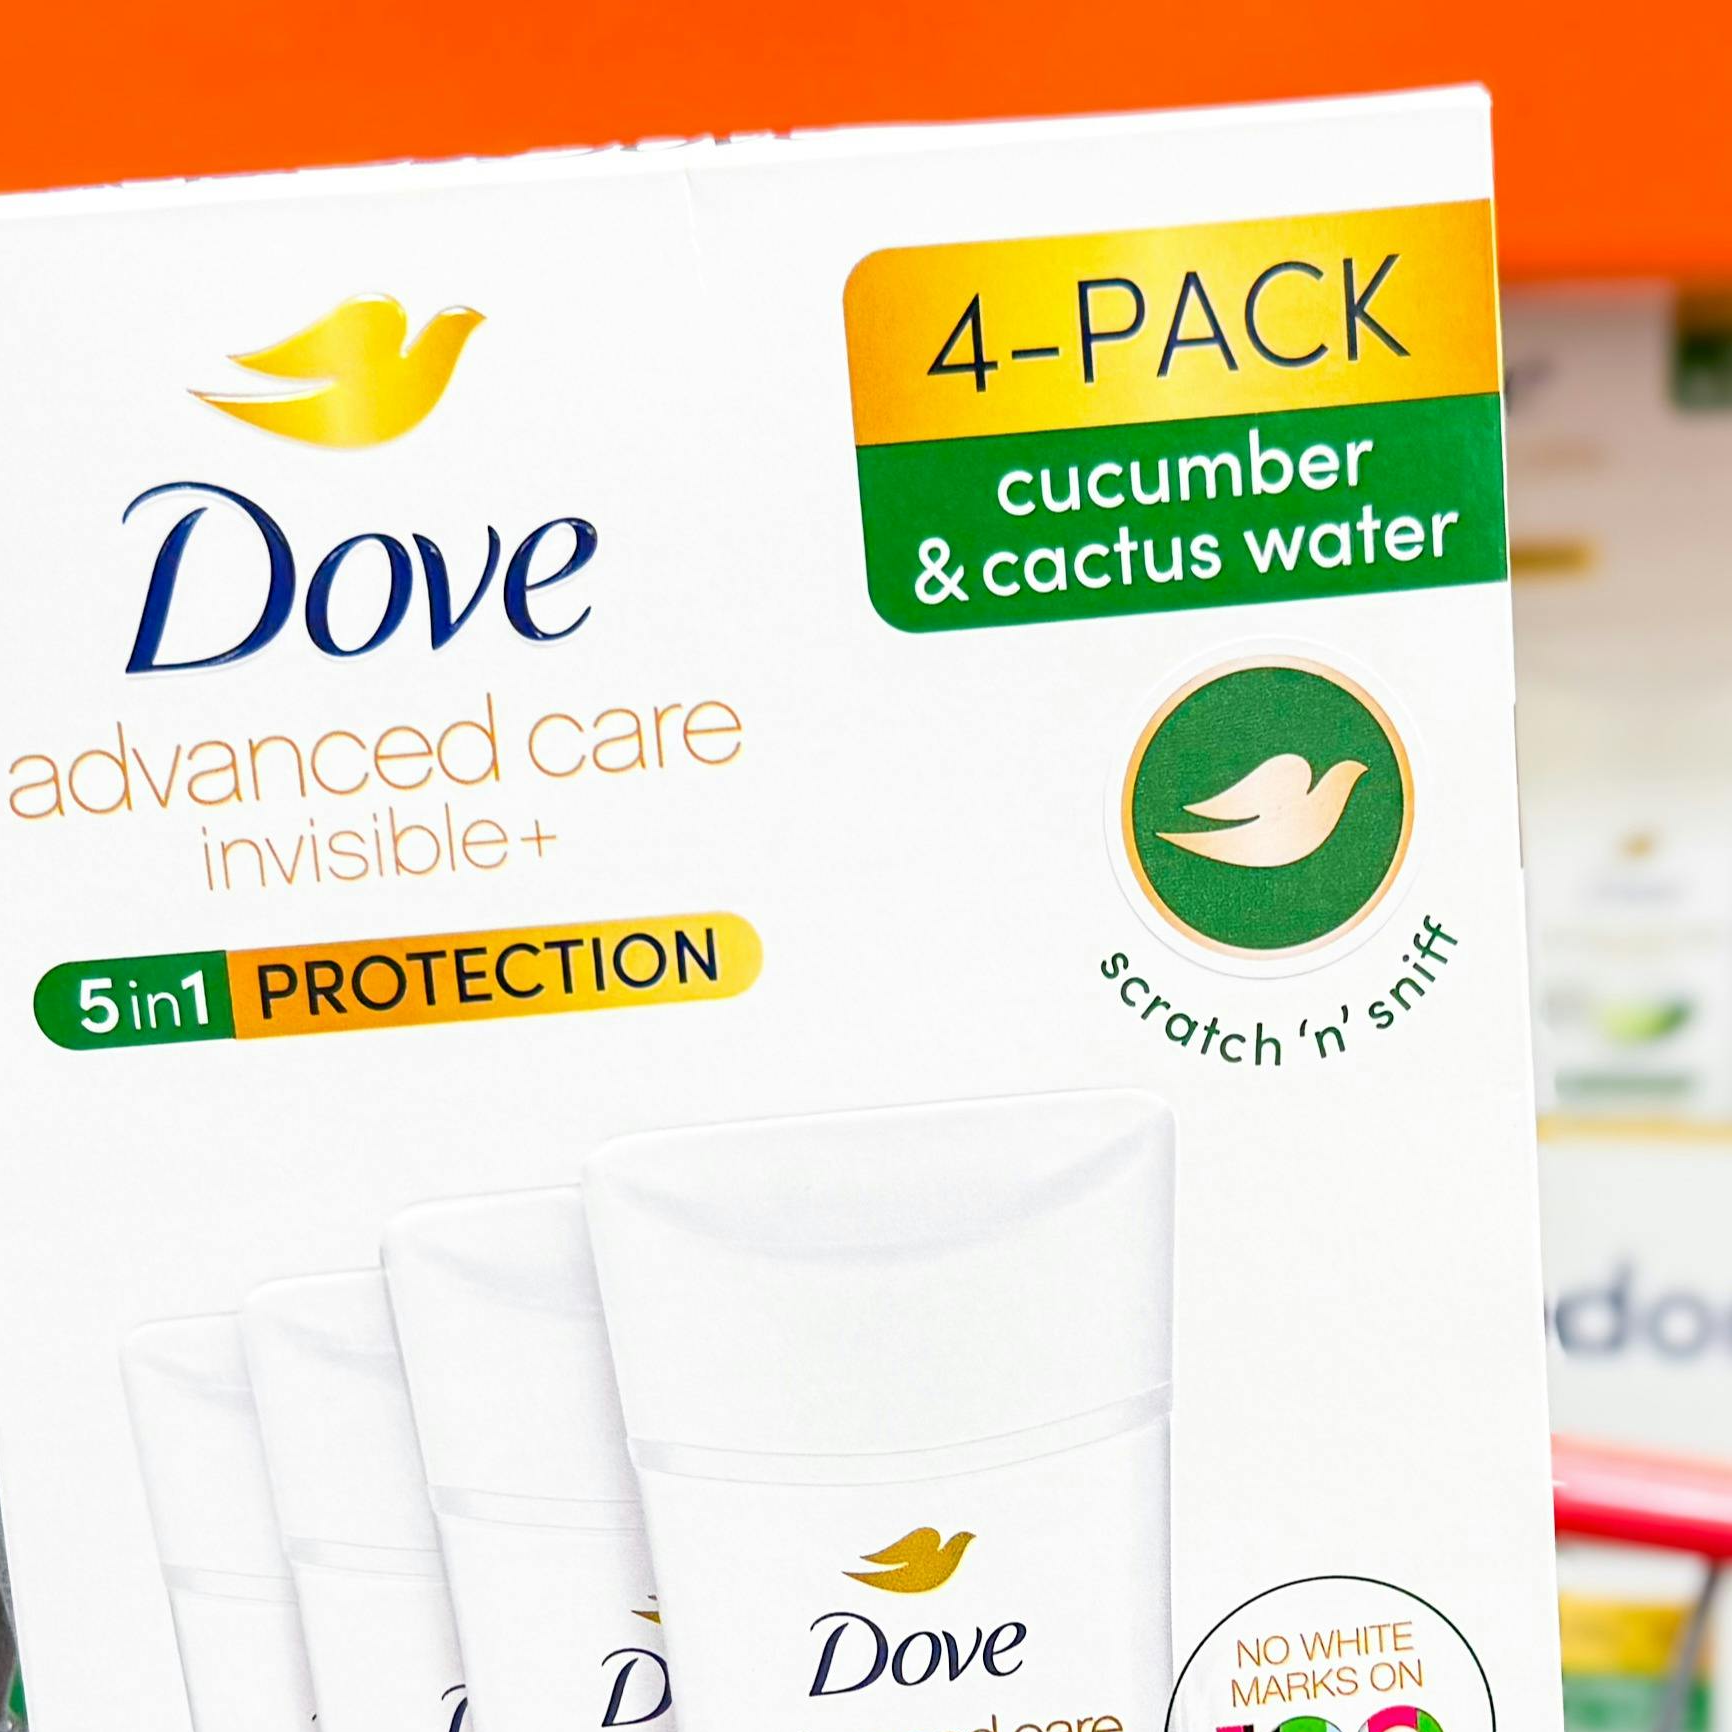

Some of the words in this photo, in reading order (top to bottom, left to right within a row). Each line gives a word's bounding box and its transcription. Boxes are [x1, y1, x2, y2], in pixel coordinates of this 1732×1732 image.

[926, 252, 1410, 393] 4-PACK
[997, 428, 1373, 515] cucumber
[122, 480, 599, 674] Dove
[913, 537, 968, 604] &
[982, 527, 1222, 598] cactus
[1243, 505, 1460, 575] water
[8, 692, 498, 819] advanced
[528, 700, 742, 778] care
[201, 803, 557, 892] invisible+
[256, 928, 718, 1019] PROTECTION
[1100, 949, 1282, 1067] scratch
[1368, 914, 1459, 1030] sniff
[808, 1612, 1027, 1697] Dove
[1231, 1667, 1358, 1707] MARKS
[1370, 1659, 1423, 1692] ON
[1237, 1636, 1290, 1668] NO
[1300, 1622, 1414, 1660] WHITE
